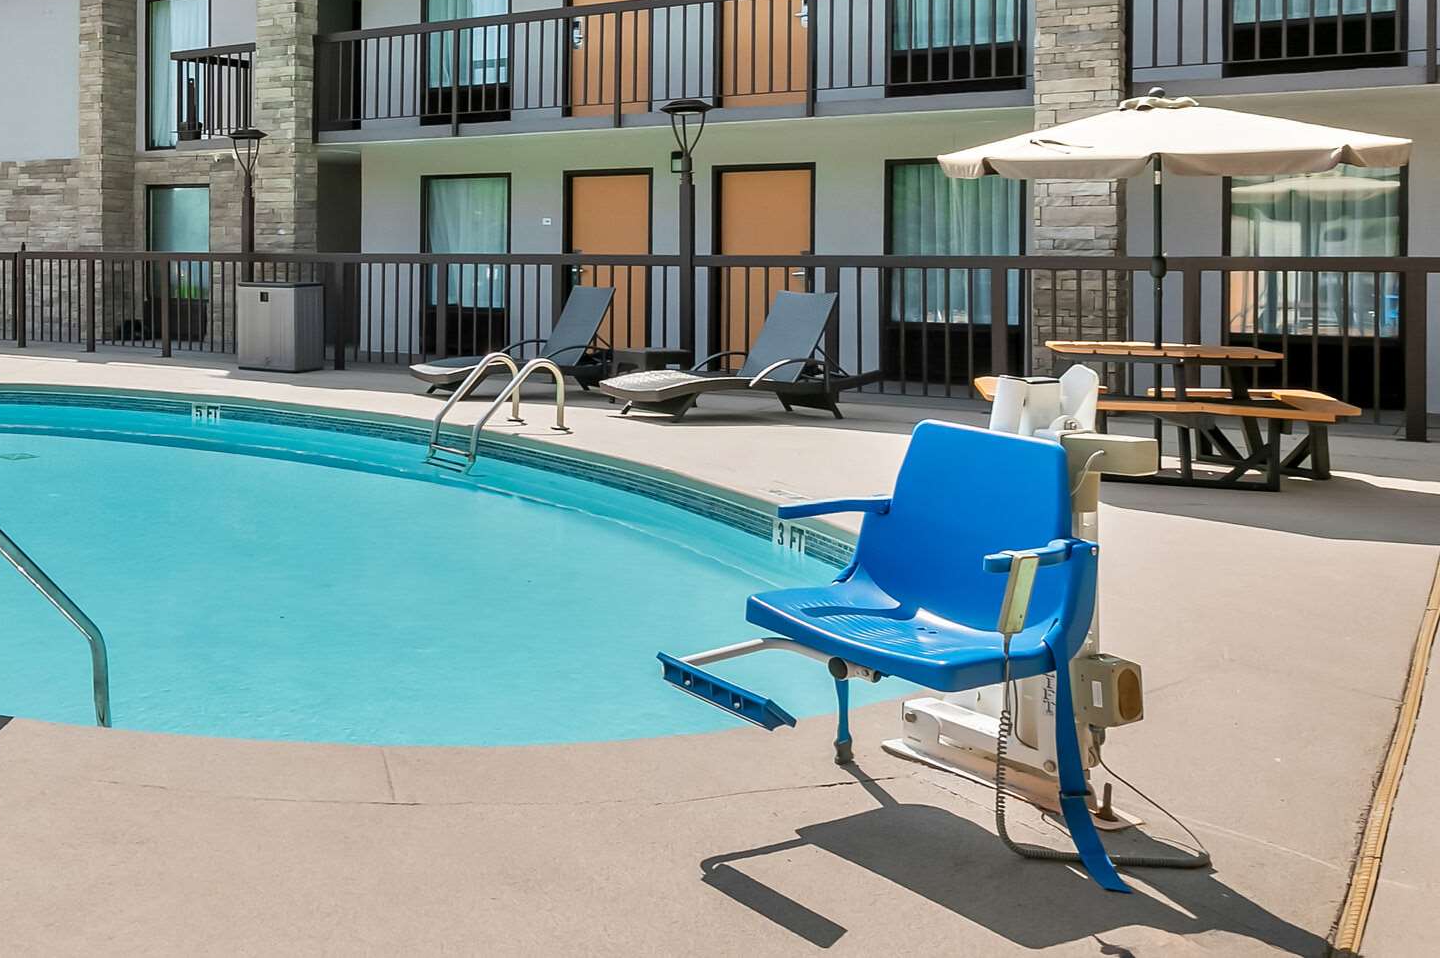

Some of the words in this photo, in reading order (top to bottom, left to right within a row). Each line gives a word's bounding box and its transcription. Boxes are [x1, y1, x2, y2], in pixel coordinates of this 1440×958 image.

[195, 405, 202, 417] 5
[207, 405, 219, 418] FT
[777, 521, 785, 546] 3
[789, 525, 805, 553] FT
